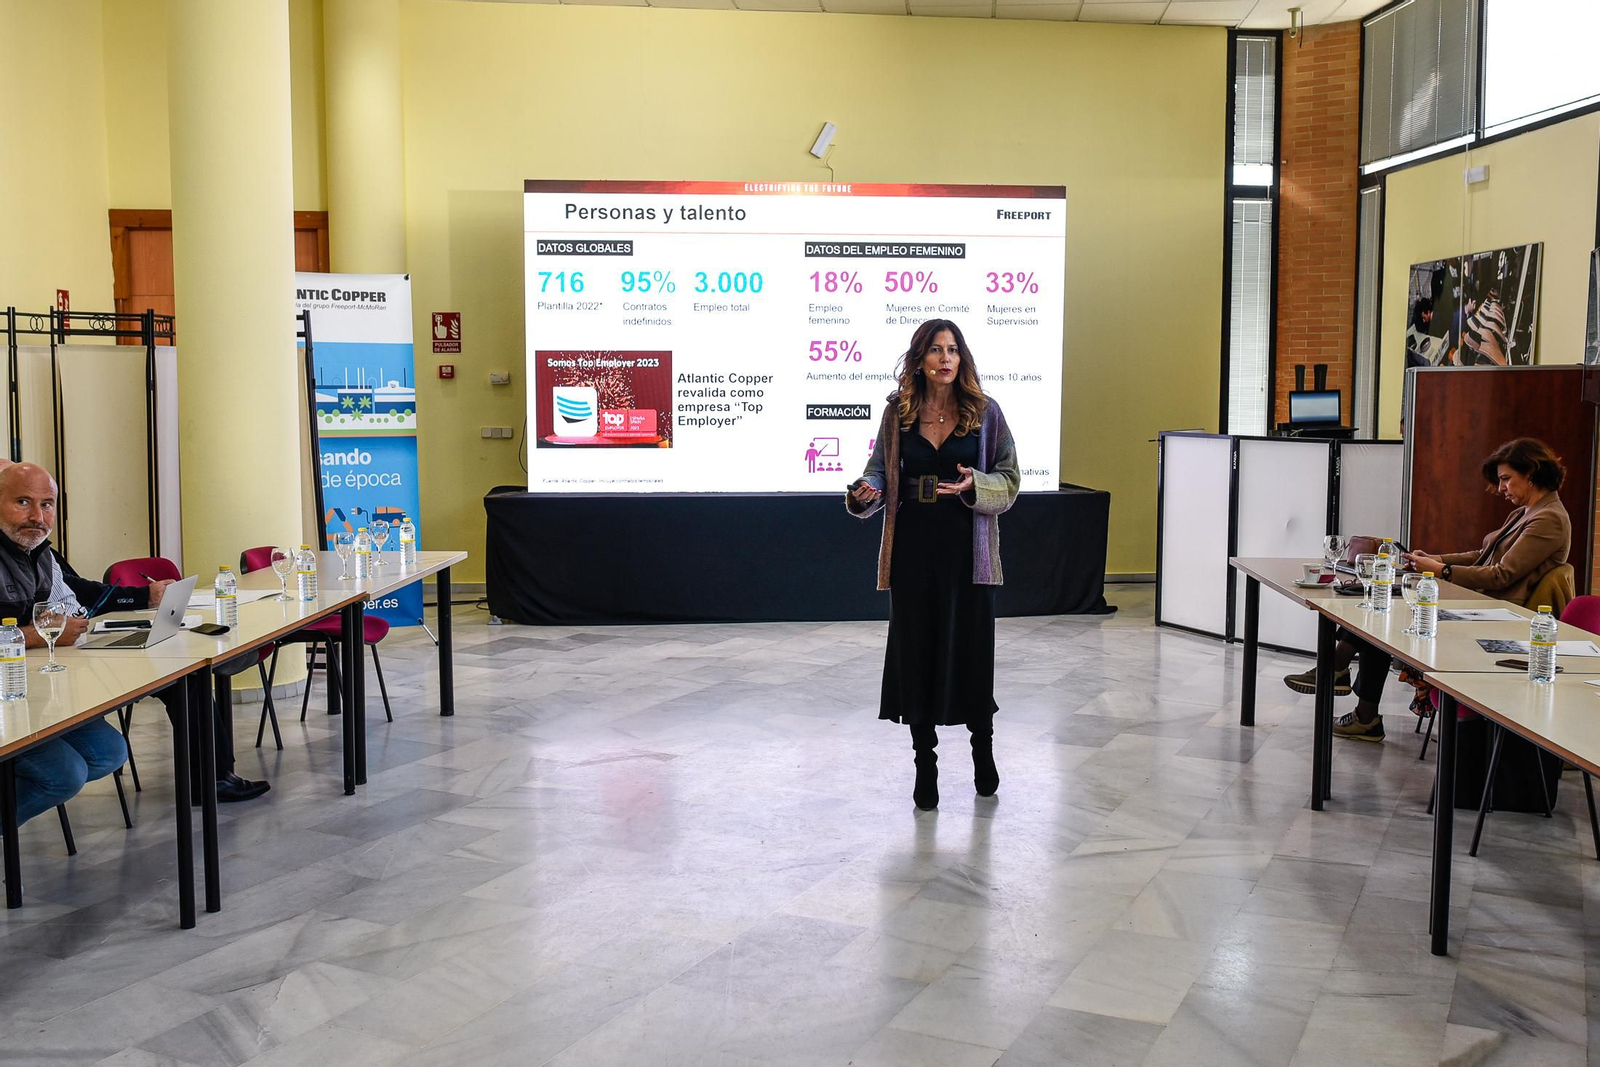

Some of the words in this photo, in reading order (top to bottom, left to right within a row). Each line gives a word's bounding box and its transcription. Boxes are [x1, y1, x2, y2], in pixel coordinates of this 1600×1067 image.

[744, 183, 800, 192] ELECTRIFYING
[804, 184, 819, 192] THE
[822, 184, 852, 193] FUTURE
[565, 203, 656, 220] Personas
[663, 207, 674, 224] y
[680, 204, 746, 221] talento
[538, 243, 573, 252] DATOS
[575, 243, 631, 254] GLOBALES
[806, 244, 841, 255] DATOS
[843, 245, 863, 255] DEL
[865, 245, 907, 256] EMPLEO
[909, 246, 963, 256] FEMENINO
[537, 271, 585, 293] 716
[620, 270, 676, 294] 95%
[694, 271, 764, 294] 3.000
[809, 270, 863, 294] 18%
[884, 270, 939, 294] 50%
[985, 271, 1039, 294] 33%
[331, 288, 386, 302] COPPER
[537, 301, 574, 311] Plantilla
[622, 302, 668, 312] Contratos
[693, 302, 728, 314] Empleo
[730, 303, 750, 312] total
[808, 303, 843, 315] Empleo
[886, 304, 922, 314] Mujeres
[938, 303, 970, 313] Comité
[986, 304, 1022, 315] Mujeres
[1024, 306, 1036, 314] en
[622, 316, 672, 326] indefinidos
[808, 316, 850, 326] femenino
[886, 316, 897, 324] de
[986, 316, 1039, 326] Supervisión
[808, 340, 862, 363] 55%
[547, 358, 576, 368] Somos
[577, 358, 594, 369] Top
[596, 358, 635, 369] Employer
[637, 358, 660, 368] 2023
[677, 373, 725, 384] Atlantic
[728, 373, 774, 387] Copper
[806, 372, 847, 381] Aumento
[848, 372, 863, 381] del
[865, 372, 895, 382] emple
[1008, 372, 1018, 382] 10
[677, 388, 726, 398] revalida
[730, 390, 764, 398] como
[677, 404, 731, 415] empresa
[734, 402, 764, 415] “Top
[807, 406, 869, 418] FORMACIÓN
[602, 412, 624, 426] top
[677, 415, 743, 428] Employer”
[321, 470, 342, 488] de
[344, 470, 402, 490] época
